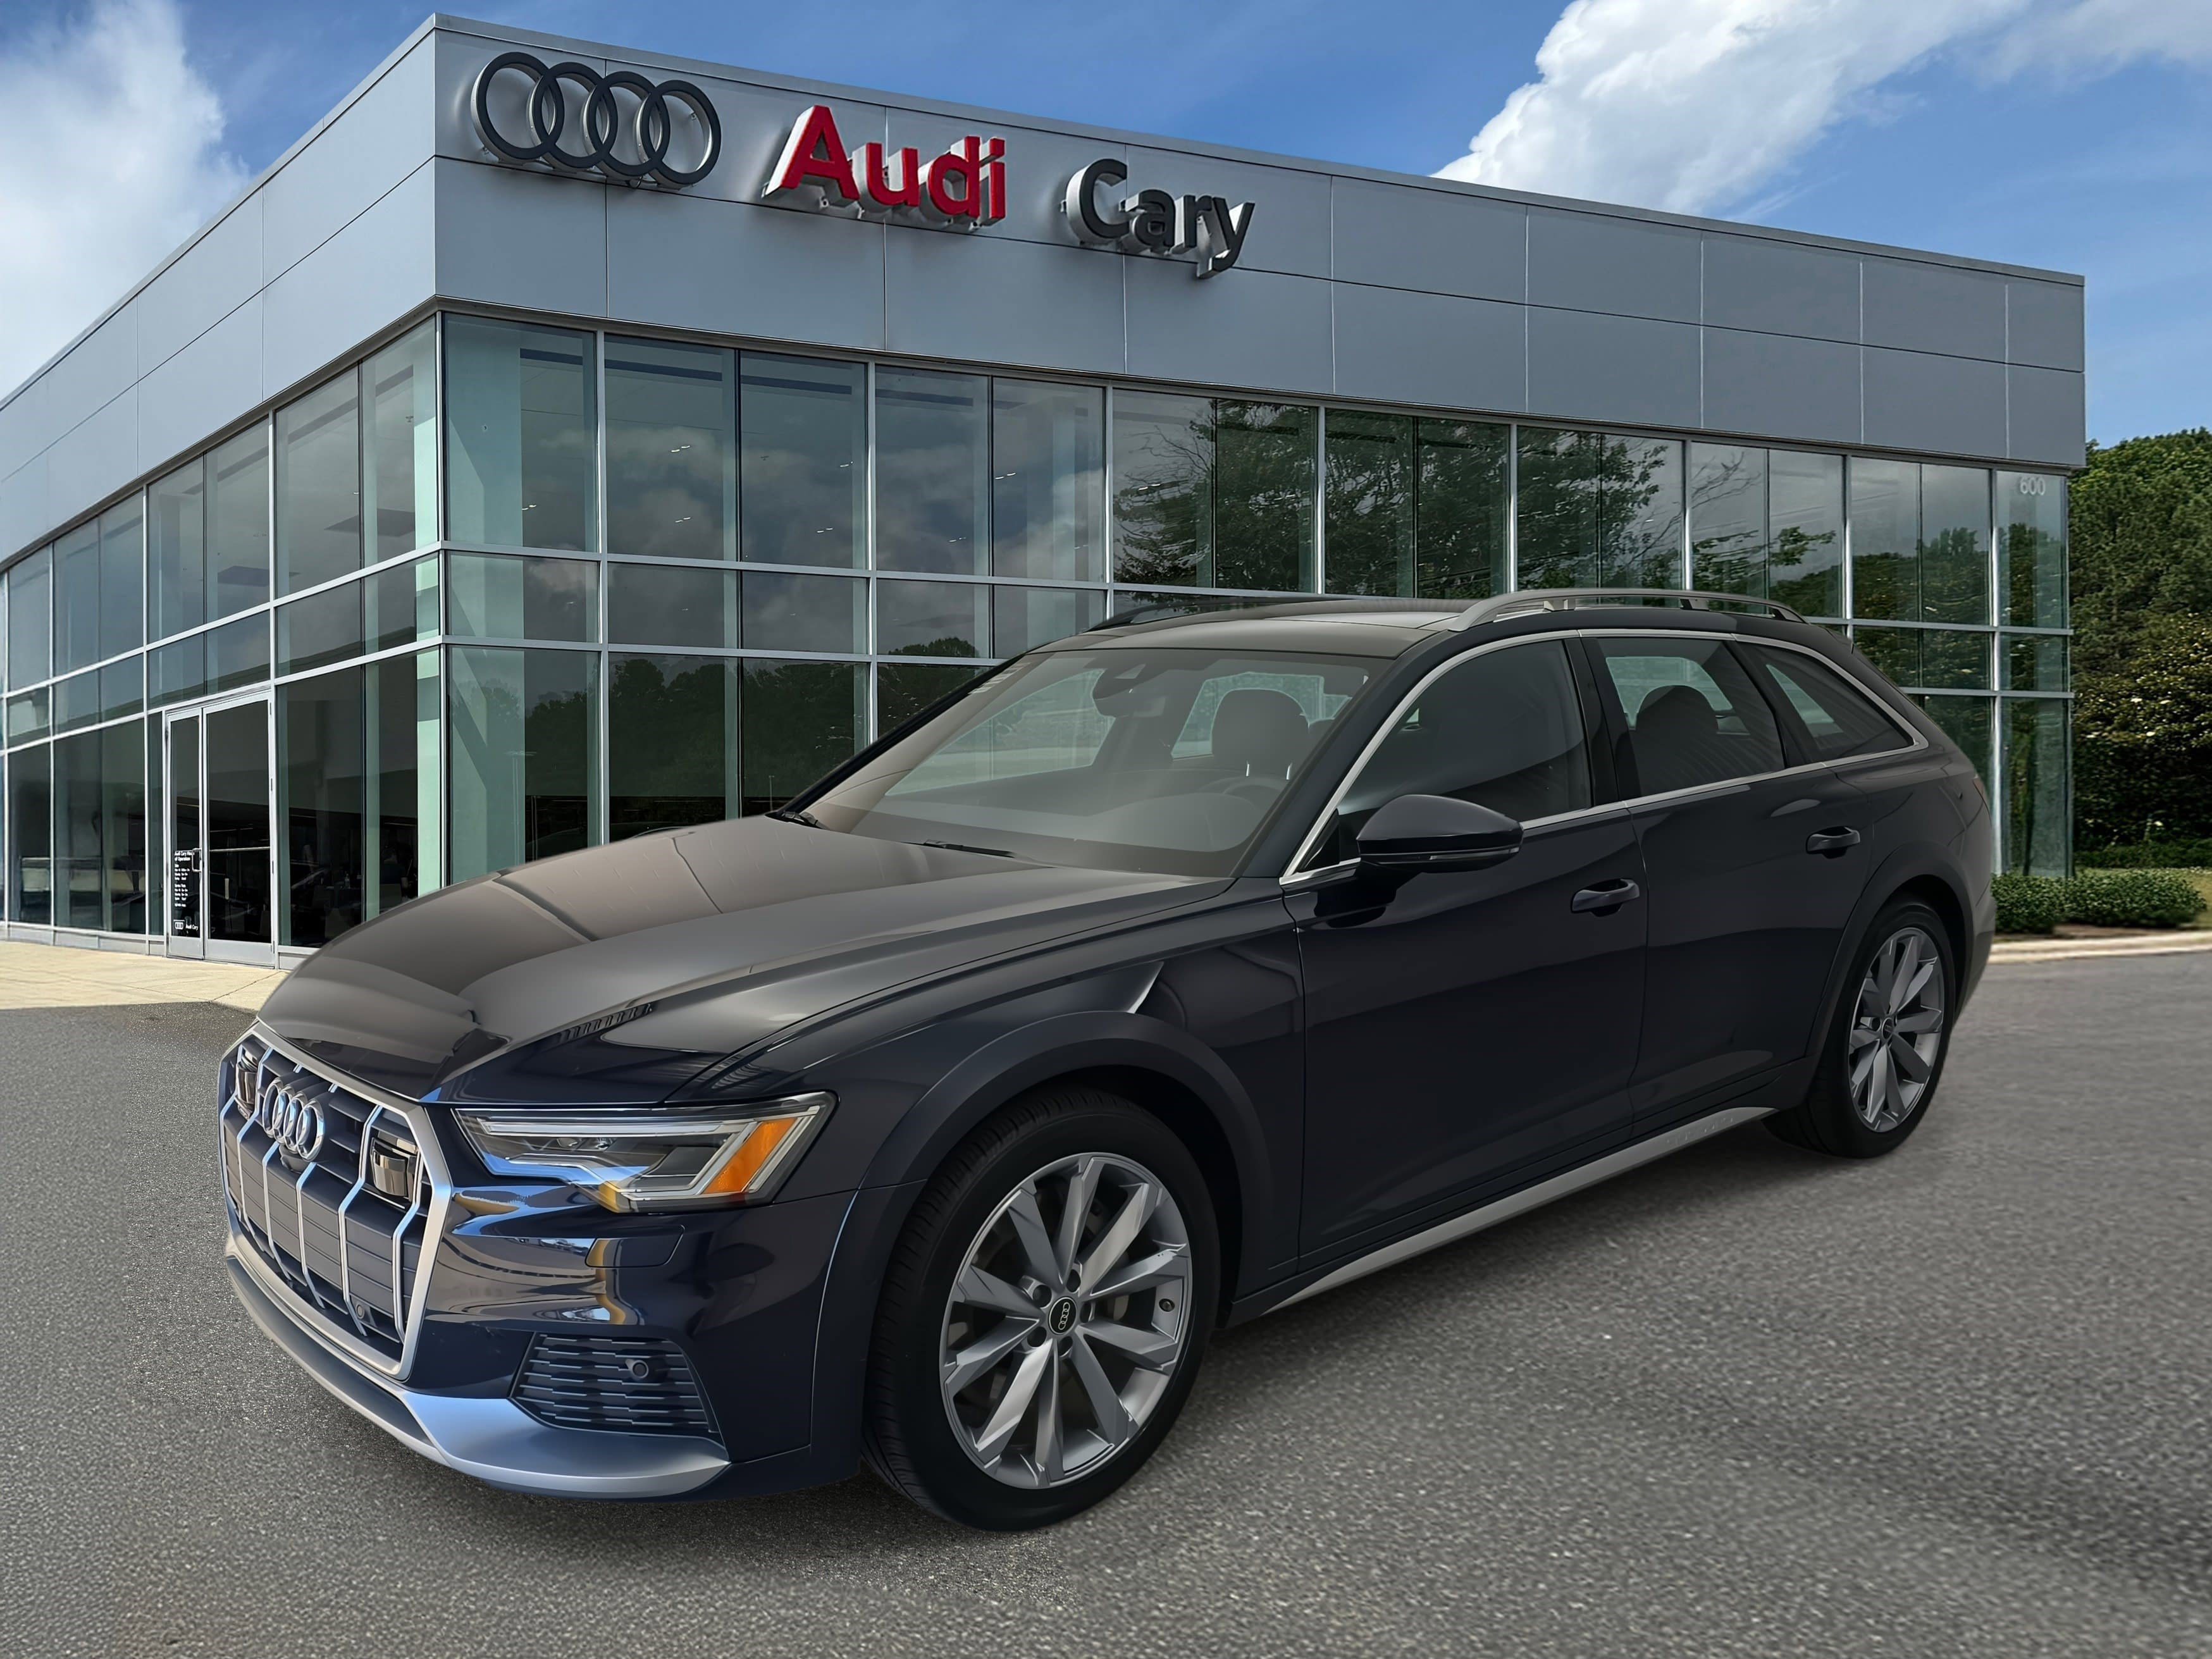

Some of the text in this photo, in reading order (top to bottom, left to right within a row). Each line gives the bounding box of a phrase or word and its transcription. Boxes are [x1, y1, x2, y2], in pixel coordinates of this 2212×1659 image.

[775, 104, 1256, 273] Audi Cary
[2020, 476, 2046, 495] 600
